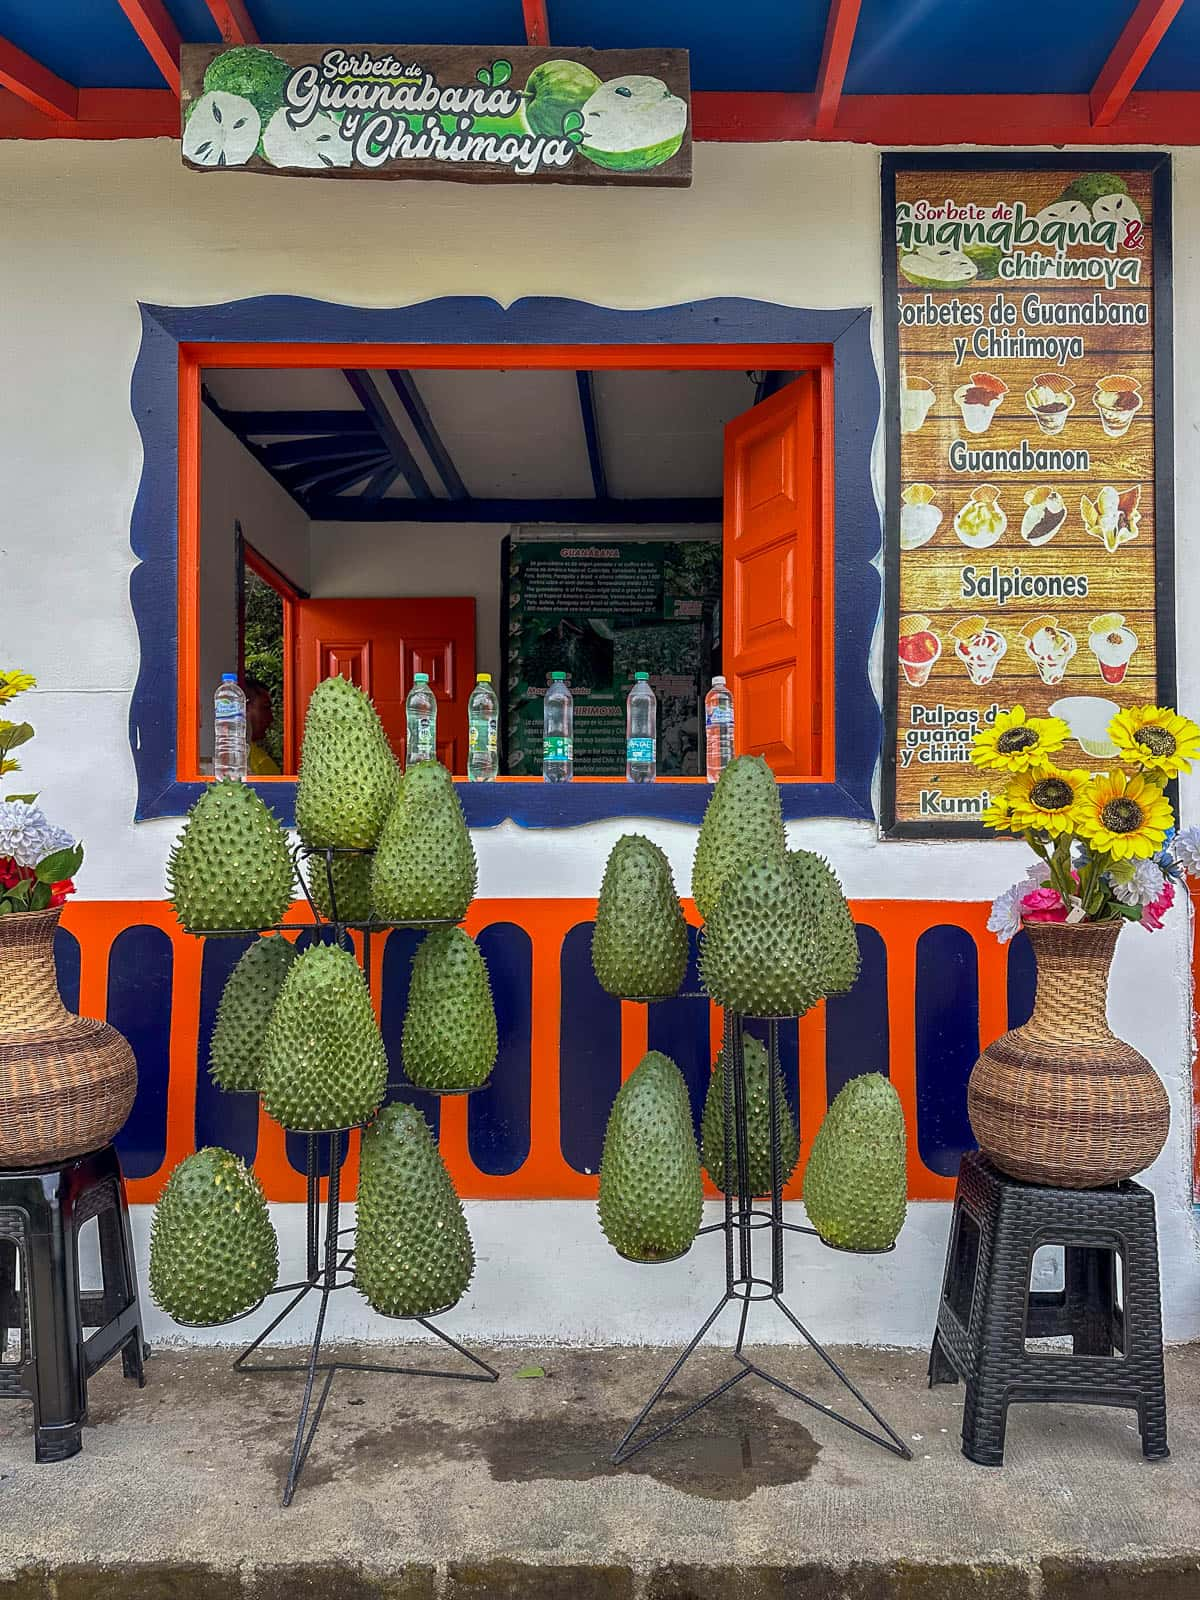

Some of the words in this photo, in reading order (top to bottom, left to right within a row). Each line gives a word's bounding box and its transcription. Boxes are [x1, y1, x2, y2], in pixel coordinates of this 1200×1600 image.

[323, 50, 402, 78] Sorbete
[405, 63, 422, 76] de
[287, 66, 517, 123] Guanabana
[343, 114, 360, 137] y
[356, 115, 574, 175] Chirimoya
[896, 203, 1118, 251] Guanabana
[1123, 220, 1143, 248] &
[915, 203, 985, 221] Sorbete
[991, 203, 1013, 220] de
[1001, 252, 1139, 288] chirimoya
[990, 295, 1016, 324] de
[1023, 294, 1147, 325] Guanabana
[955, 338, 967, 365] y
[973, 328, 1083, 365] Chirimoya
[951, 442, 1088, 471] Guanabanon
[963, 568, 1087, 604] Salpicones
[912, 706, 978, 726] Pulpas
[907, 725, 982, 746] guanab
[902, 749, 913, 766] y
[919, 745, 972, 761] chiri
[921, 791, 988, 813] Kumi
